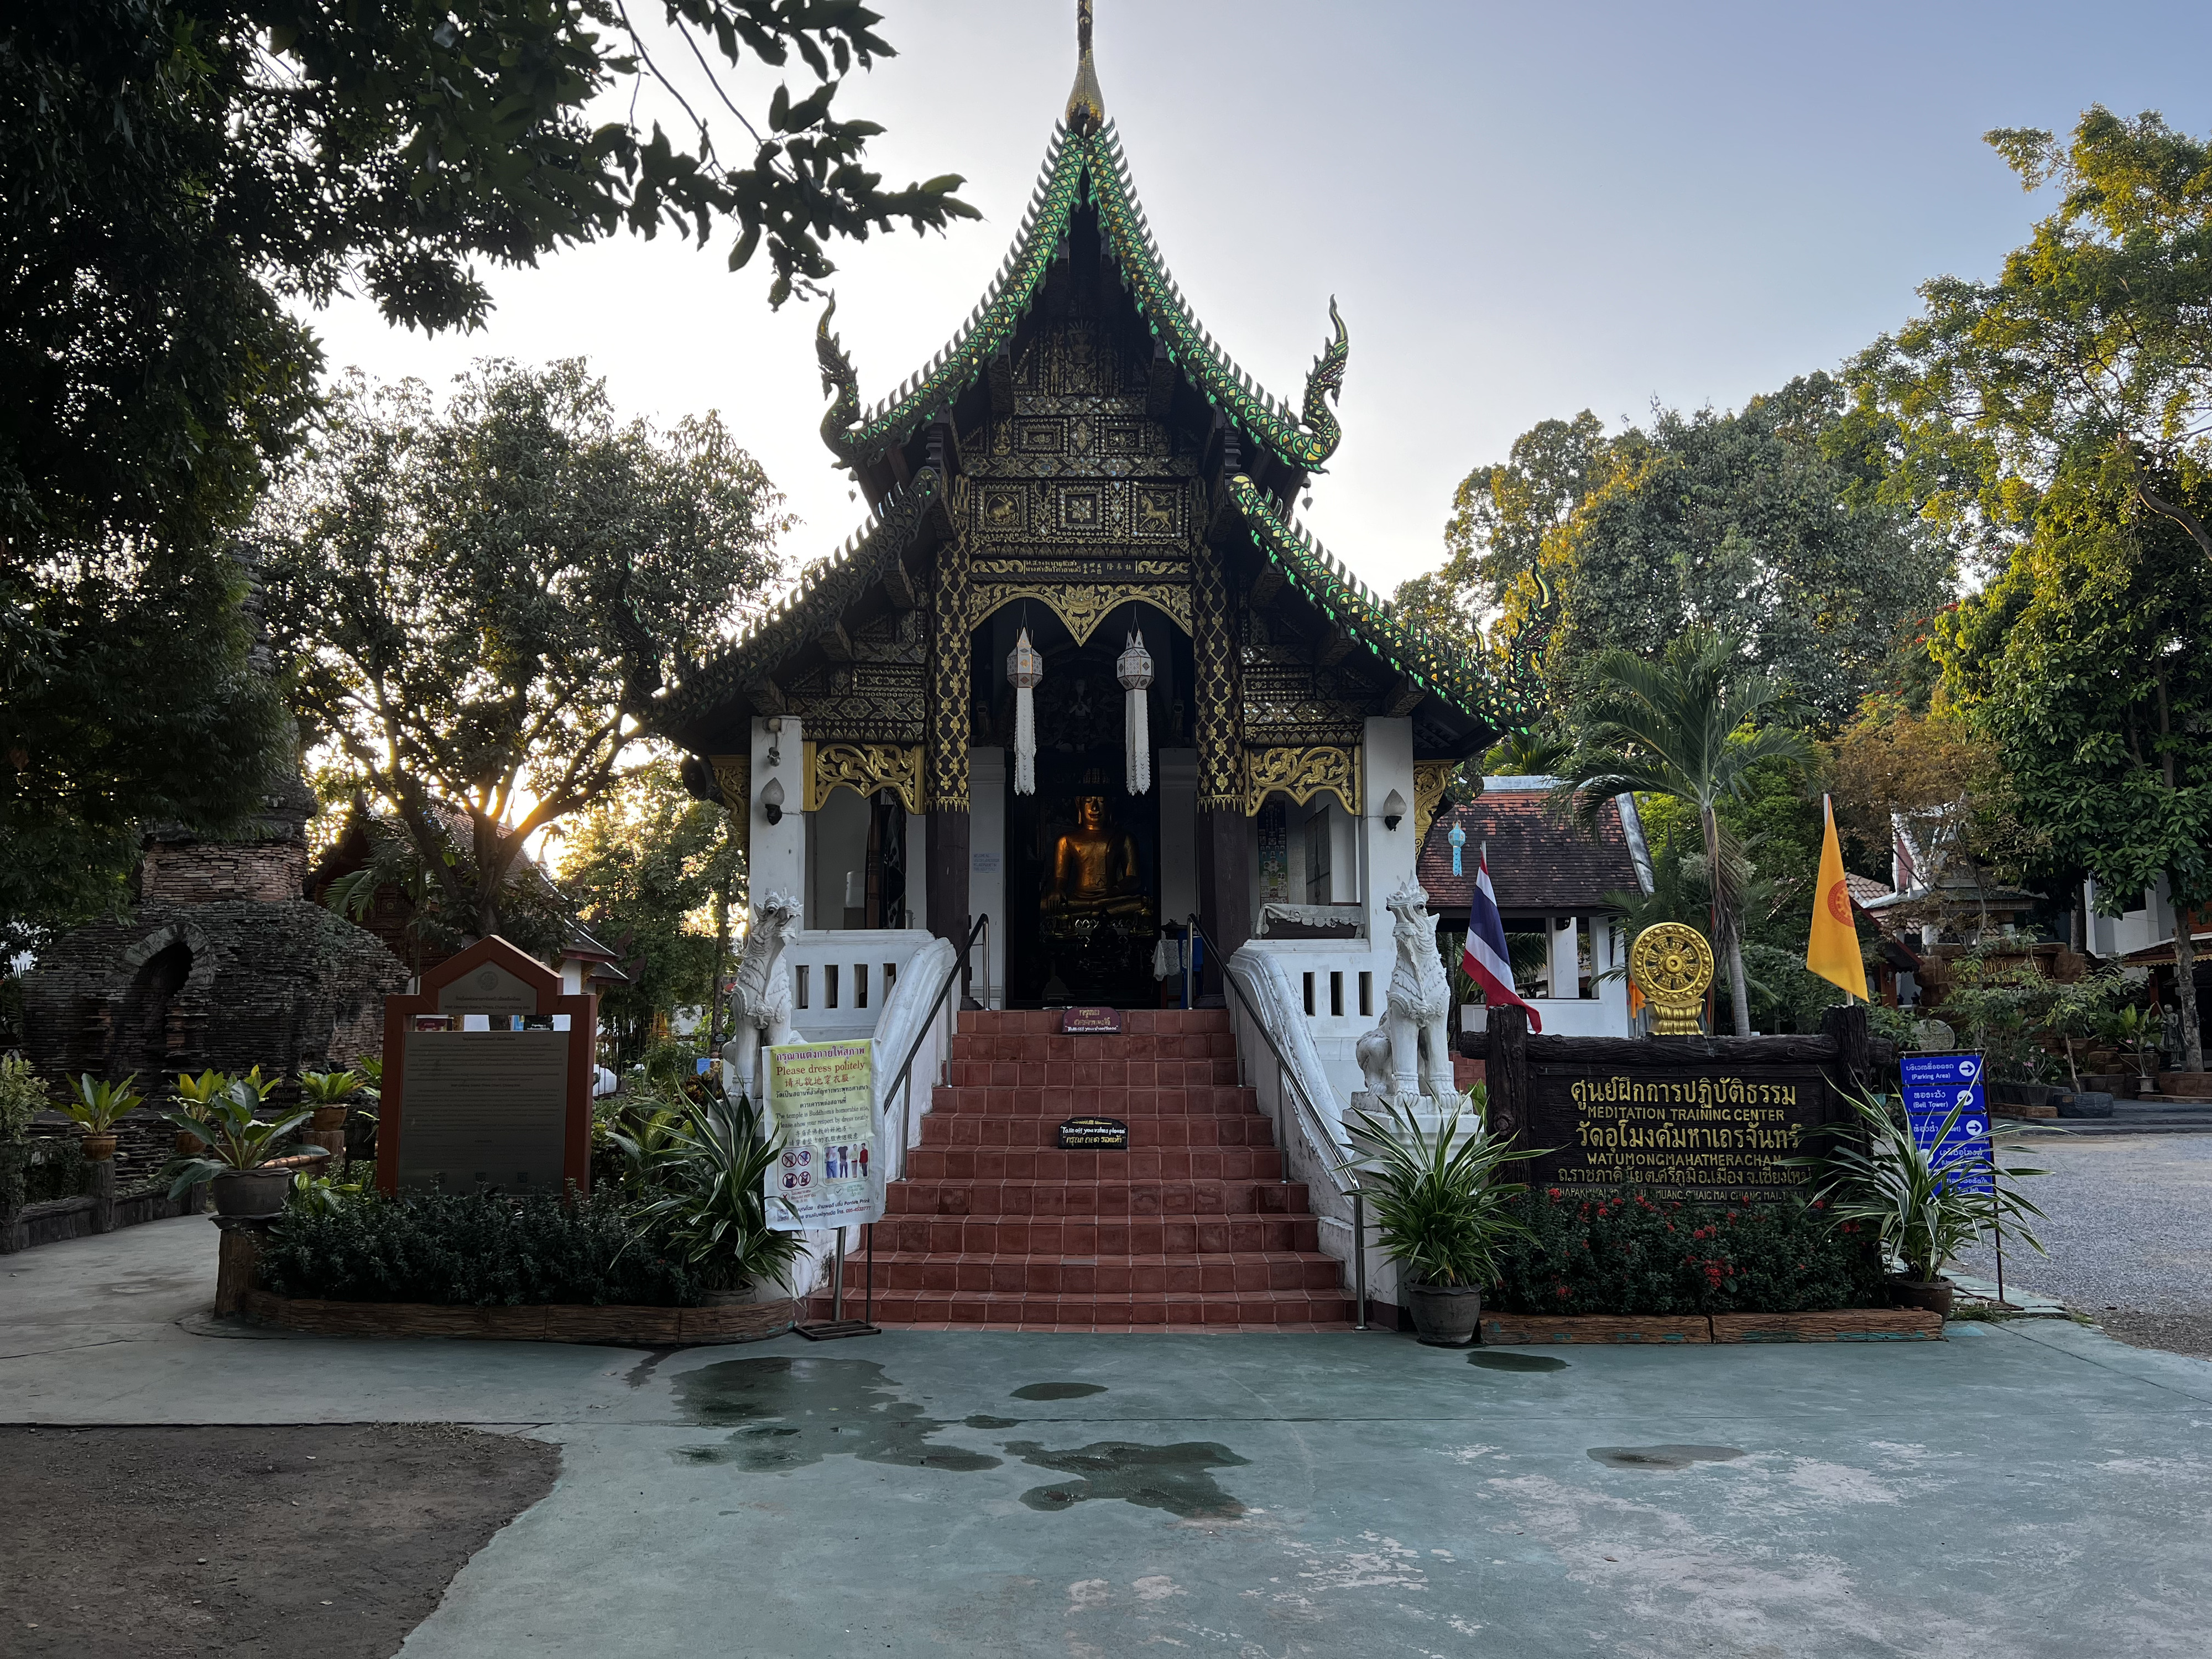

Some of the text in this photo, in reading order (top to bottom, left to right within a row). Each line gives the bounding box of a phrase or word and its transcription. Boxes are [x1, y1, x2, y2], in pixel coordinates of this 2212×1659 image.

[776, 1046, 865, 1065] กรุณาแต่งกายให้สุภาพ
[776, 1060, 865, 1076] Please dress politely
[1571, 1076, 1796, 1111] ศูนย์ฝึกการปฏิบัติธรรม
[854, 1114, 869, 1122] neatly
[1588, 1106, 1785, 1121] MEDITATION TRAINING CENTER
[1575, 1119, 1802, 1153] วัดอุโมงค์มหาเถรจันทร์
[1714, 1191, 1727, 1201] MAI
